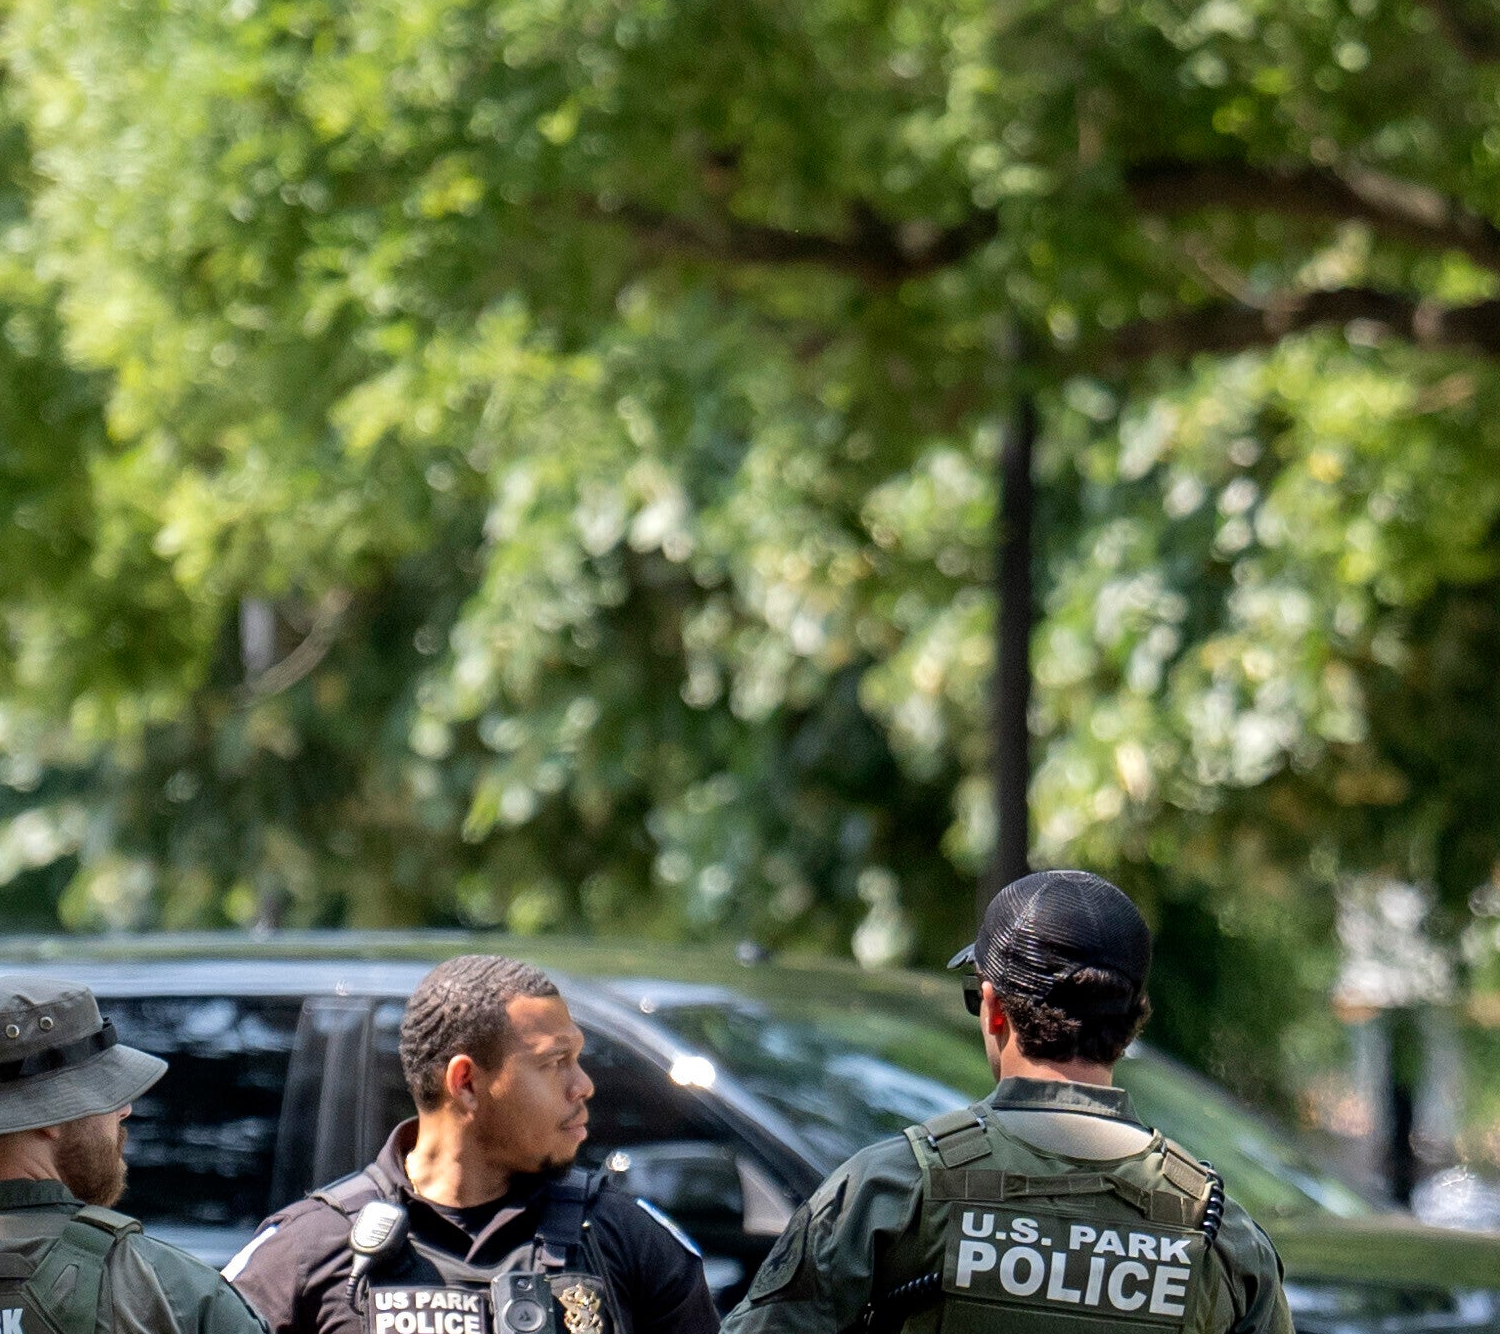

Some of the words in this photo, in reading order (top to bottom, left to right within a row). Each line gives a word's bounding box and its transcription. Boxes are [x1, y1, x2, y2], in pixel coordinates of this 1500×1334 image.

[961, 1212, 1051, 1246] U.S.
[1069, 1224, 1192, 1265] PARK
[375, 1292, 409, 1310] US
[415, 1291, 479, 1312] PARK
[956, 1240, 1191, 1316] POLICE
